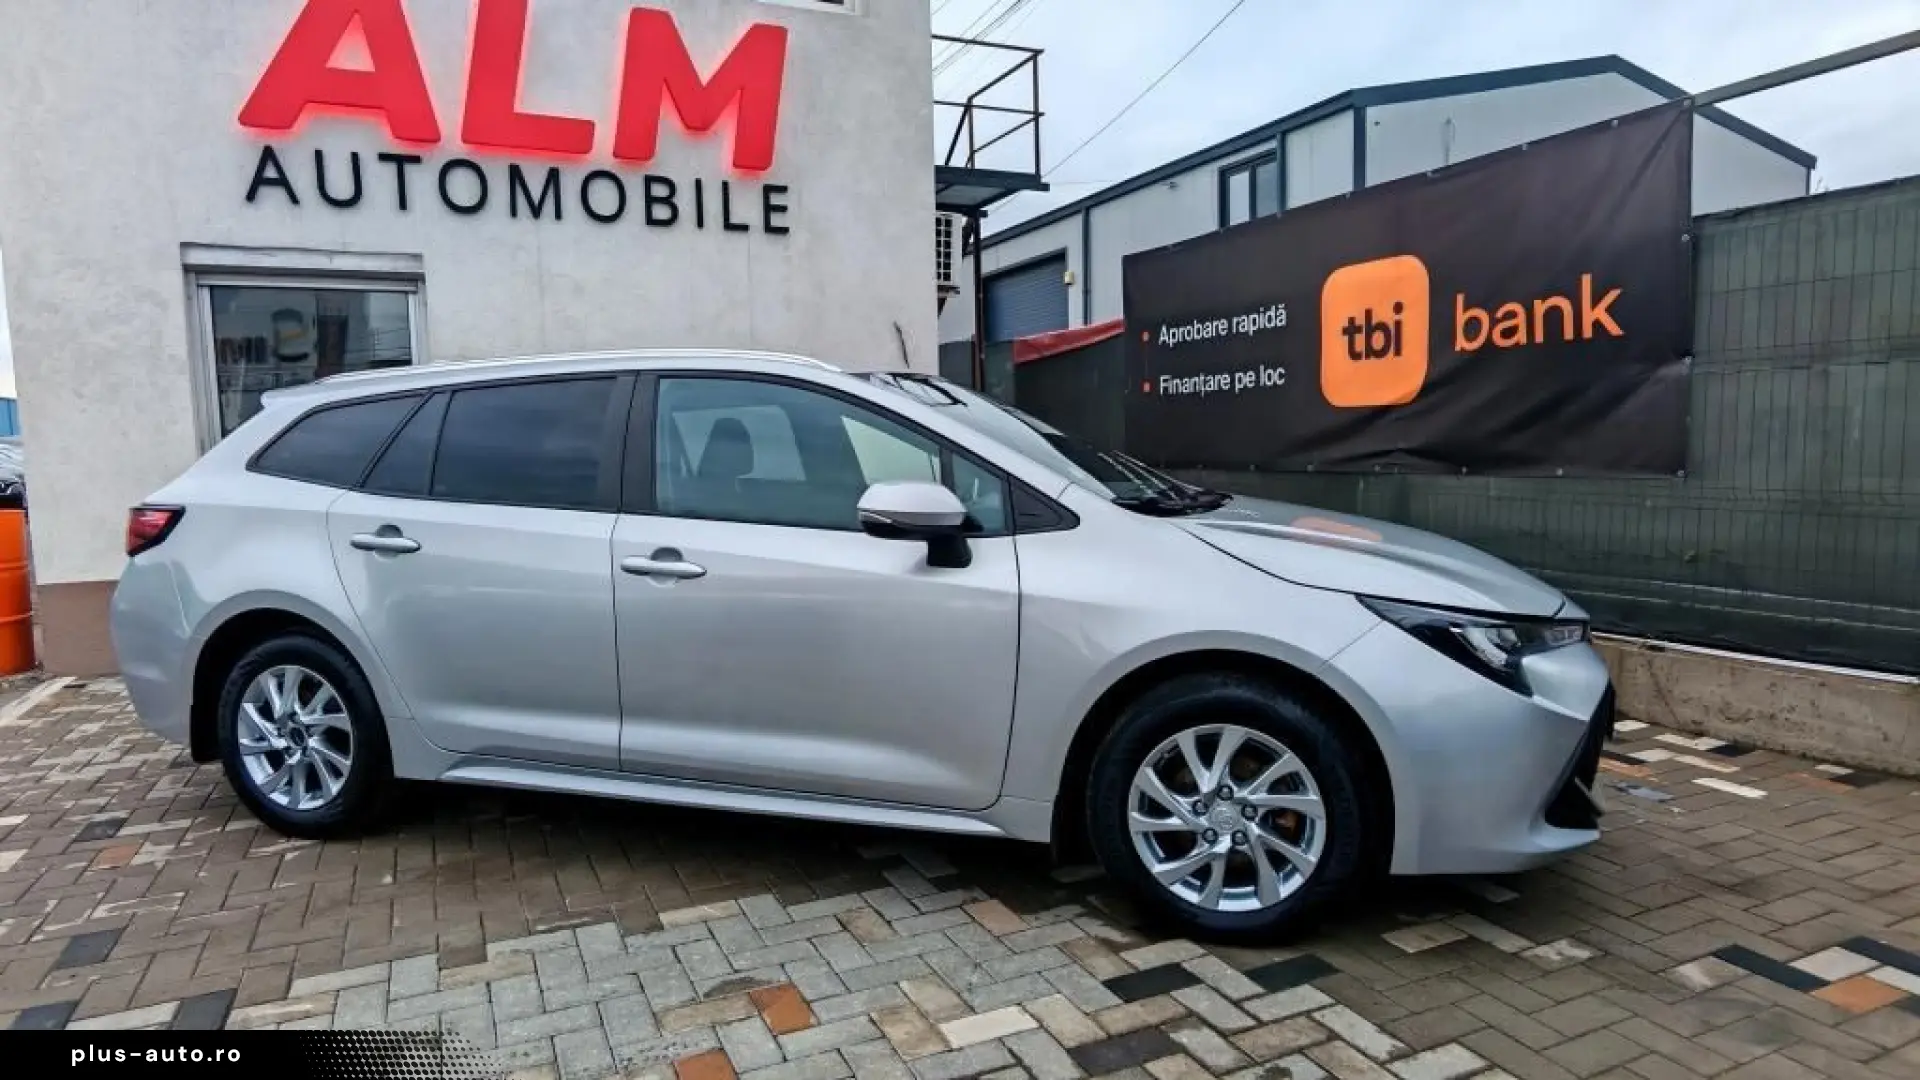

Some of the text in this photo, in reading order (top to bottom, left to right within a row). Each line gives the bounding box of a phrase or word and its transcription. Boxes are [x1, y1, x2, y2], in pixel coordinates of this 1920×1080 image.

[238, 0, 788, 172] ALM
[245, 145, 791, 235] AUTOMOBILE
[1158, 303, 1287, 348] Aprobare rapidă
[1341, 272, 1625, 361] tbi bank
[1159, 363, 1286, 398] Finanțare pe loc
